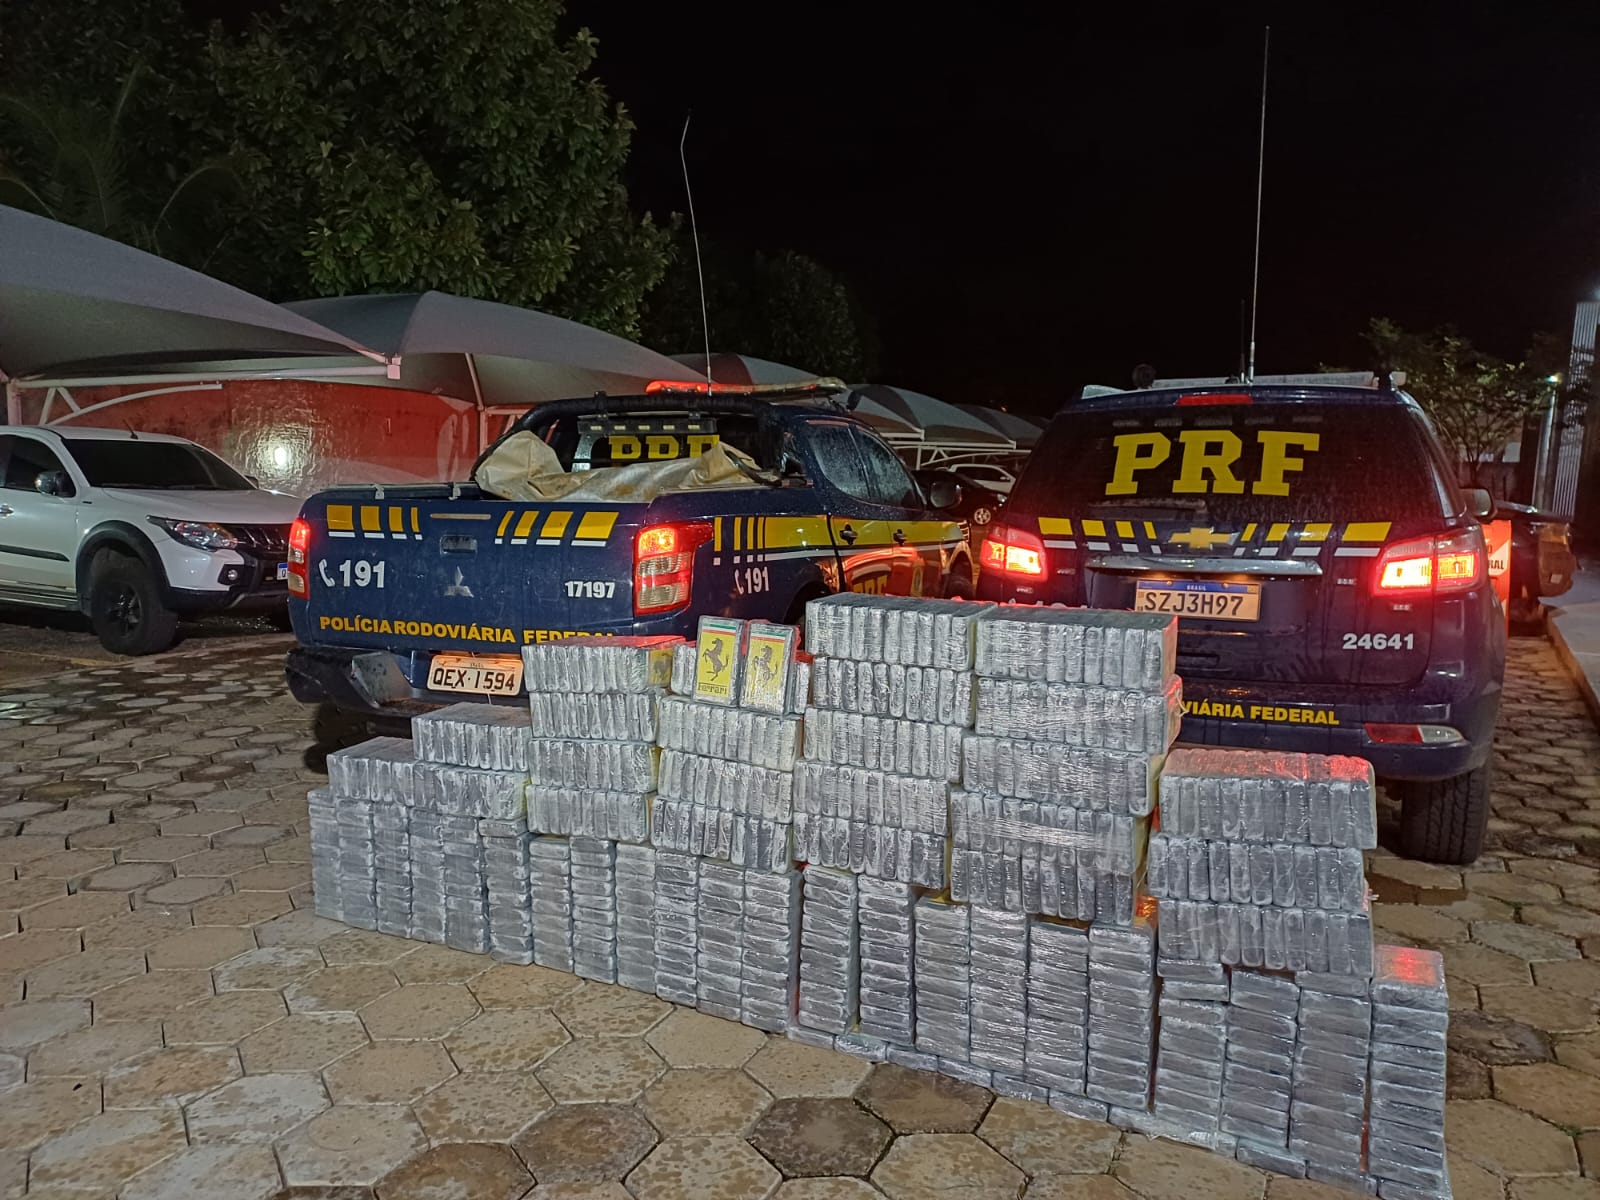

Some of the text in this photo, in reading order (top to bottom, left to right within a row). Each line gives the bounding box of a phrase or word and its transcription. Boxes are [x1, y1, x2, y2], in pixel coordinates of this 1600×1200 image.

[1105, 430, 1320, 497] PRF
[339, 559, 385, 589] 191
[745, 566, 769, 594] 191
[564, 580, 616, 599] 17197
[1144, 592, 1243, 616] SZJ3H97
[320, 614, 393, 634] POLÍCIA
[393, 620, 516, 643] RODOVIÁRIA
[1342, 633, 1415, 650] 24641
[1250, 706, 1340, 725] FEDERAL
